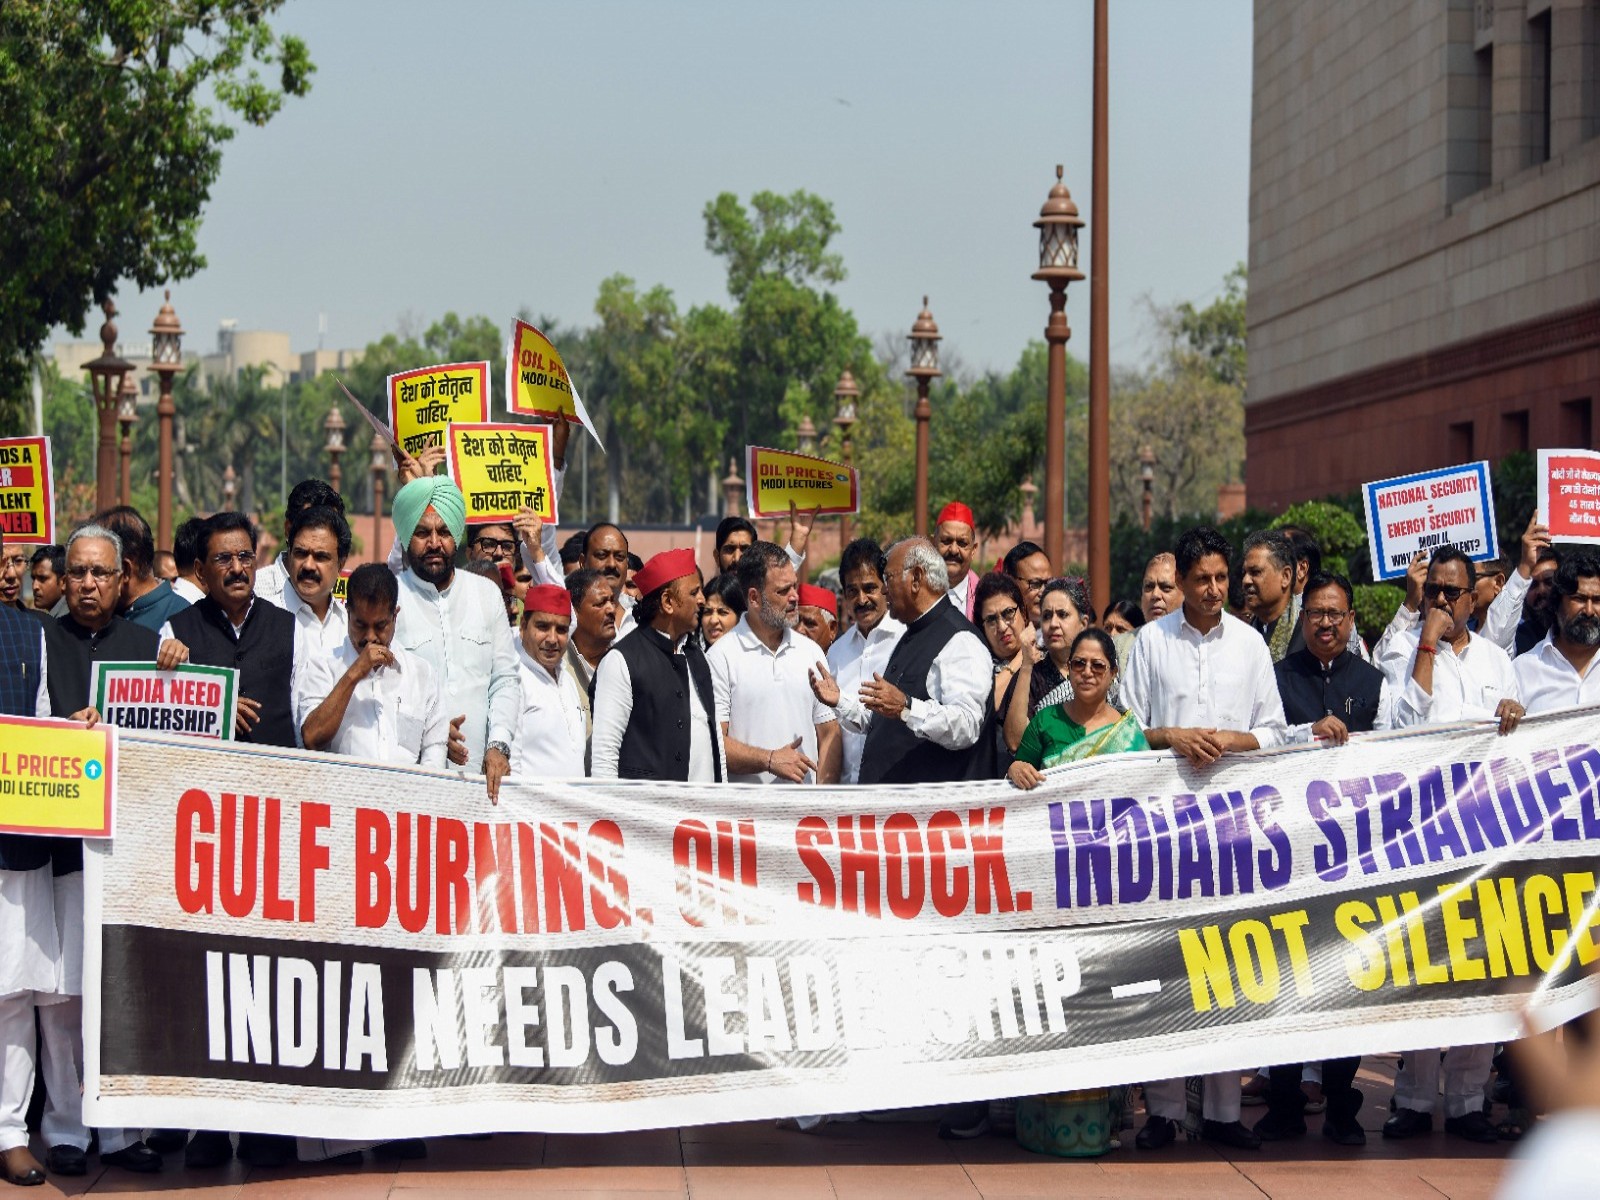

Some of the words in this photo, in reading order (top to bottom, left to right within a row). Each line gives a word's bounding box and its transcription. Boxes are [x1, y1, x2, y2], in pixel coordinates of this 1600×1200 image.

[521, 349, 545, 370] OIL
[401, 381, 418, 403] देश
[420, 375, 436, 399] को
[438, 373, 473, 403] नेतृत्व
[521, 370, 548, 386] MODI
[23, 448, 32, 463] A
[461, 432, 485, 457] देश
[486, 432, 505, 456] को
[506, 432, 537, 465] नेतृत्व
[0, 468, 12, 487] R
[485, 459, 527, 485] चाहिए,
[760, 464, 782, 476] OIL
[786, 466, 834, 480] PRICES
[761, 479, 785, 490] MODI
[788, 479, 833, 489] LECTURES
[470, 491, 521, 511] कायरता
[523, 487, 545, 512] नहीं
[1378, 486, 1428, 510] NATIONAL
[1430, 476, 1478, 499] SECURITY
[1387, 517, 1426, 538] ENERGY
[1429, 507, 1476, 531] SECURITY
[1418, 533, 1440, 549] MODI
[1391, 552, 1411, 567] WHY
[109, 678, 165, 704] INDIA
[170, 679, 221, 708] NEED
[107, 706, 220, 735] LEADERSHIP,
[17, 753, 82, 779] PRICES
[0, 780, 15, 795] DI
[19, 781, 80, 798] LECTURES
[174, 788, 331, 922] GULF
[795, 806, 1032, 919] SHOCK.
[1049, 784, 1292, 909] INDIANS
[1307, 743, 1600, 882] STRANDED
[205, 950, 389, 1073] INDIA
[413, 961, 638, 1071] NEEDS
[660, 940, 1081, 1061] LEADESHIP
[1178, 909, 1314, 1012] NOT
[1335, 870, 1600, 992] SILENCE
